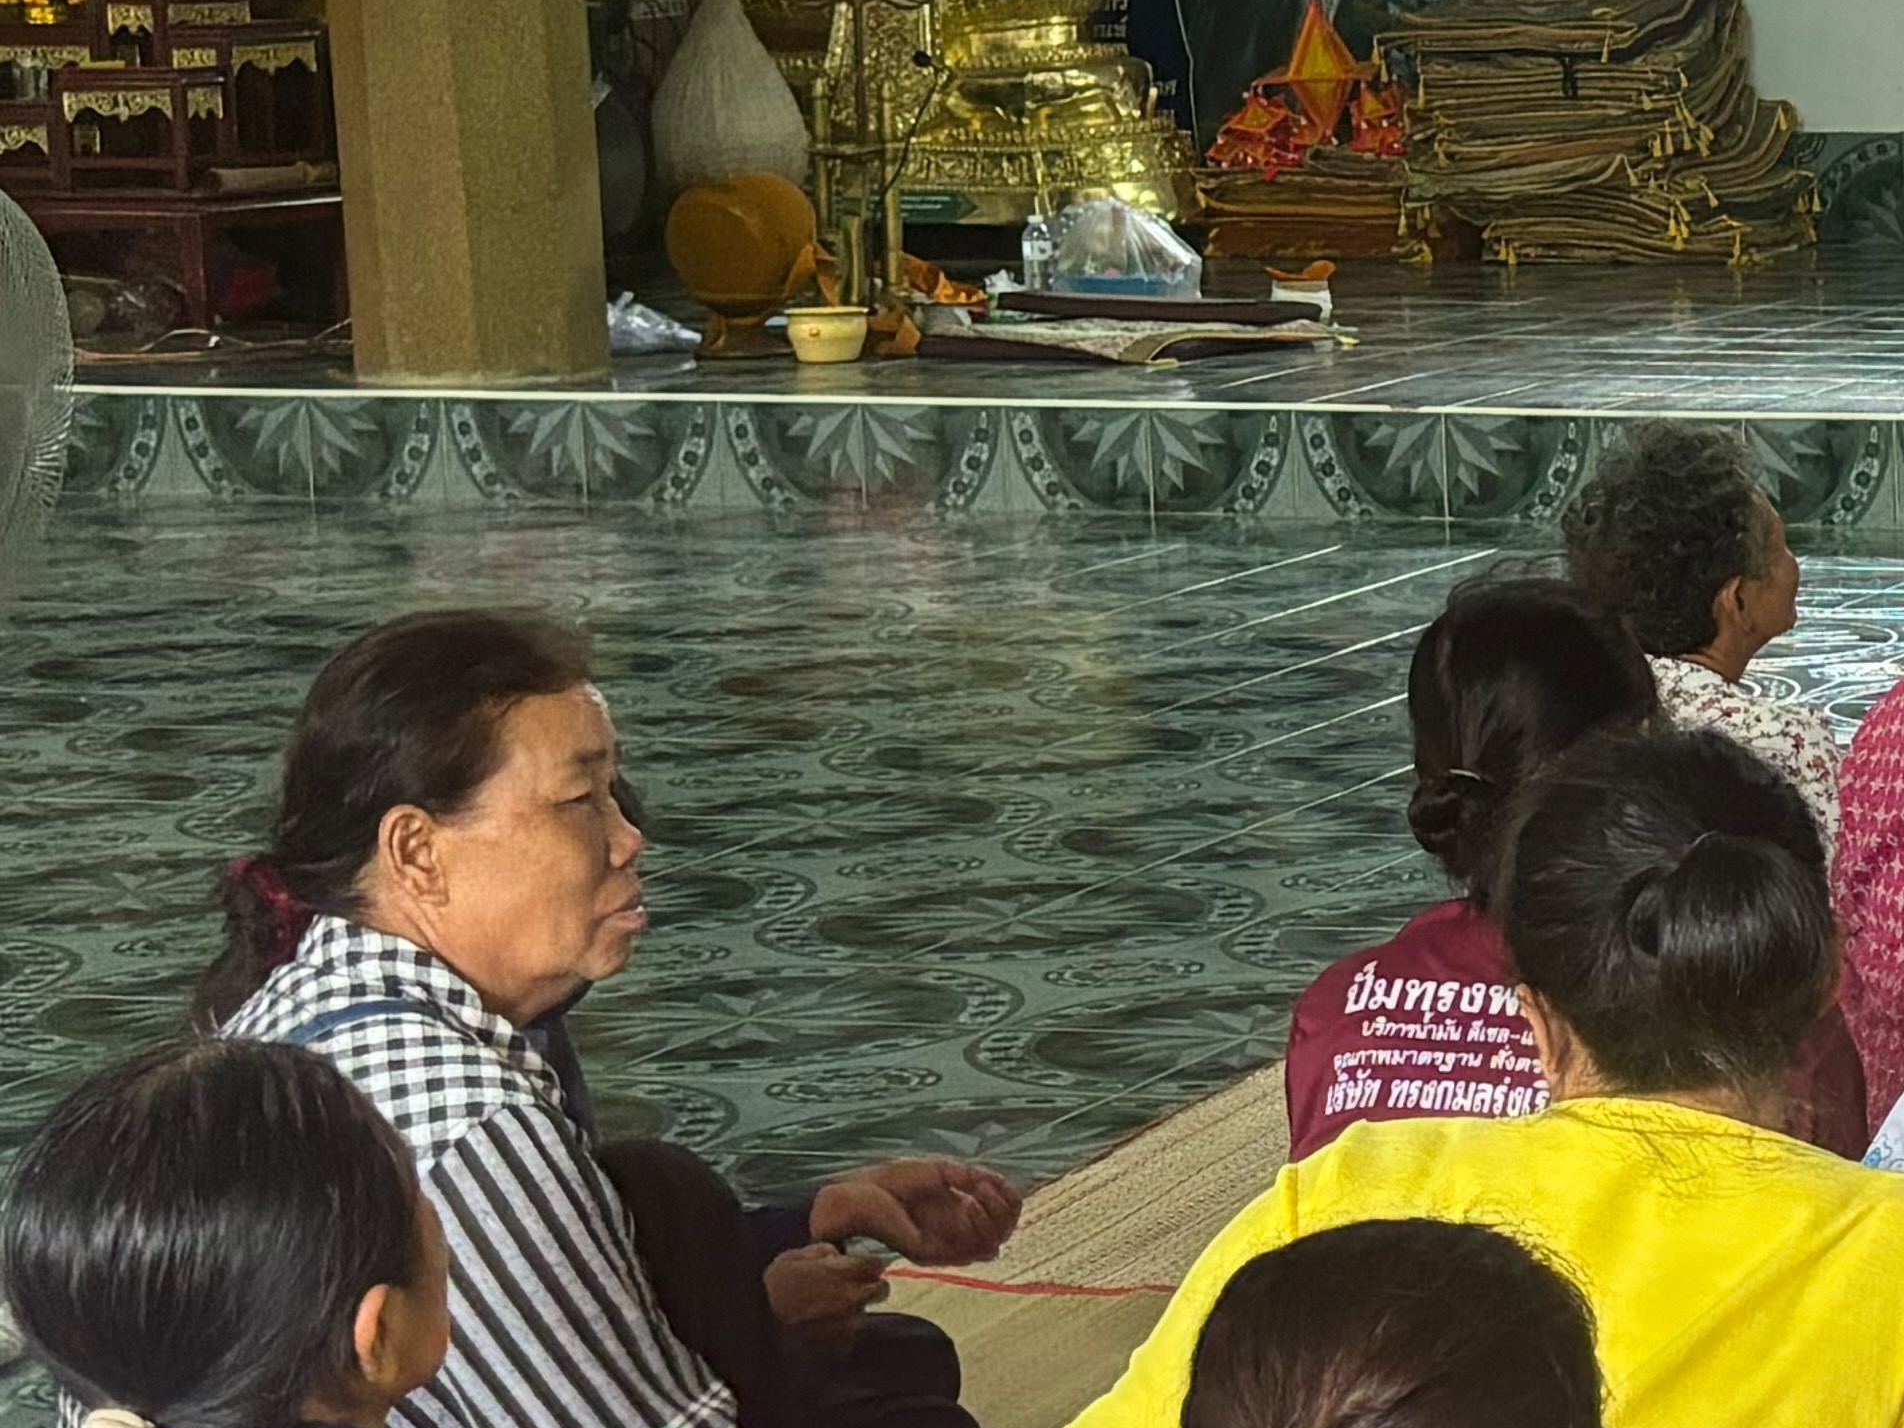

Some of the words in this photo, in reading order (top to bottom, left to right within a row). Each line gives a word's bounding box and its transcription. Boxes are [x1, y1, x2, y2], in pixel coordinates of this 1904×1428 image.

[1344, 960, 1521, 1016] ปั๊มทรงพ
[1466, 1018, 1536, 1047] ดีเซล-แ
